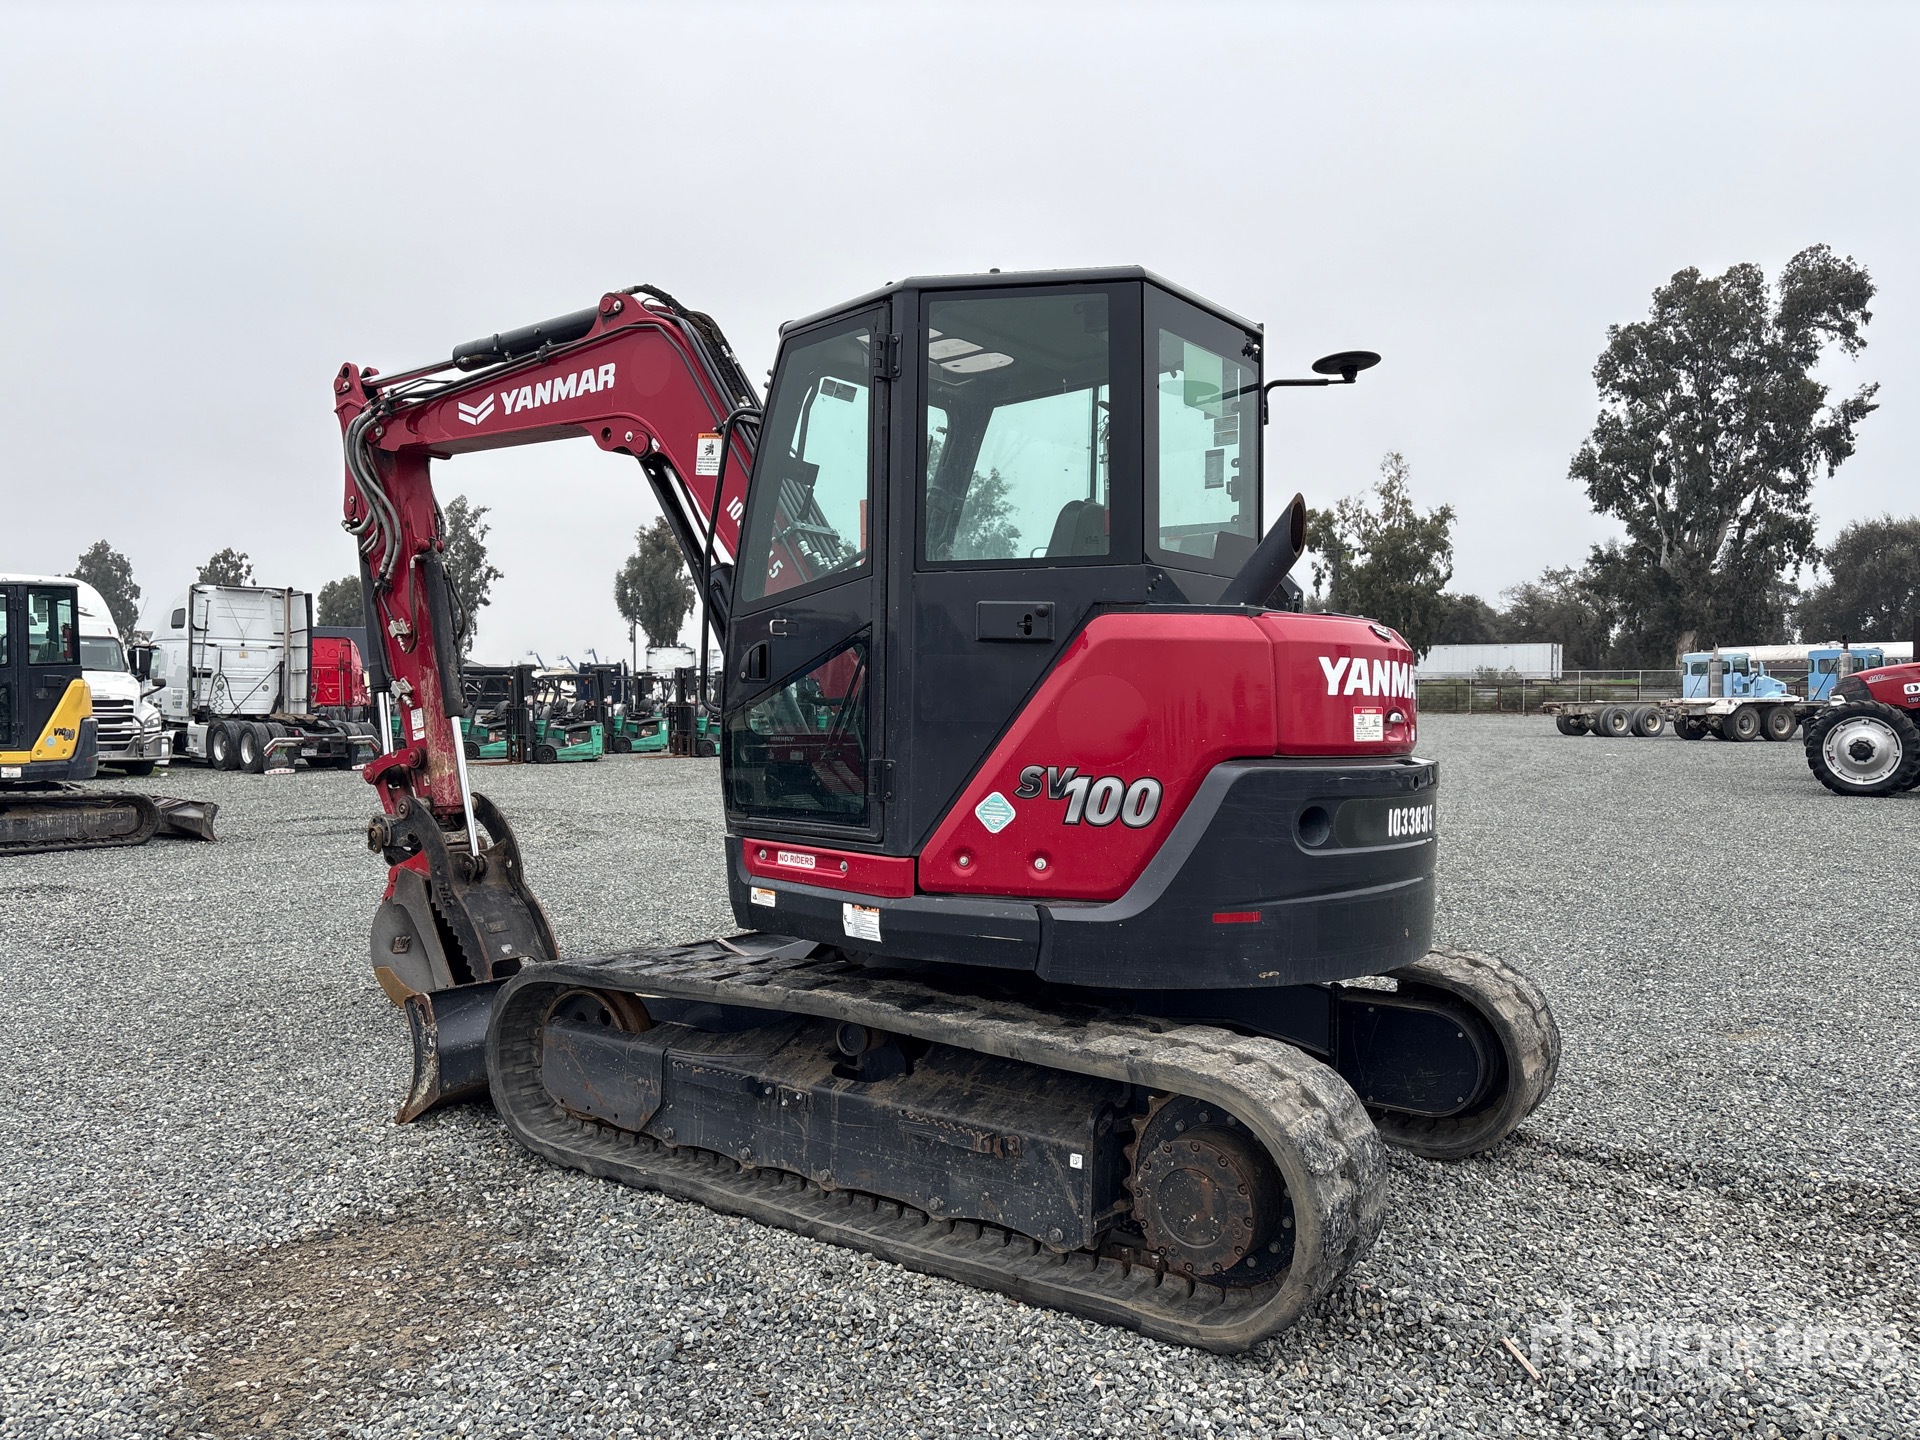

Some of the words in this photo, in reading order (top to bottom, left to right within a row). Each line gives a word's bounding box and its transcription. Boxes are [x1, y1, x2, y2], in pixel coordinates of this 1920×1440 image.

[501, 362, 616, 415] YANMAR
[1318, 656, 1416, 700] YANMA
[779, 853, 789, 863] NO
[790, 855, 814, 866] RIDERS
